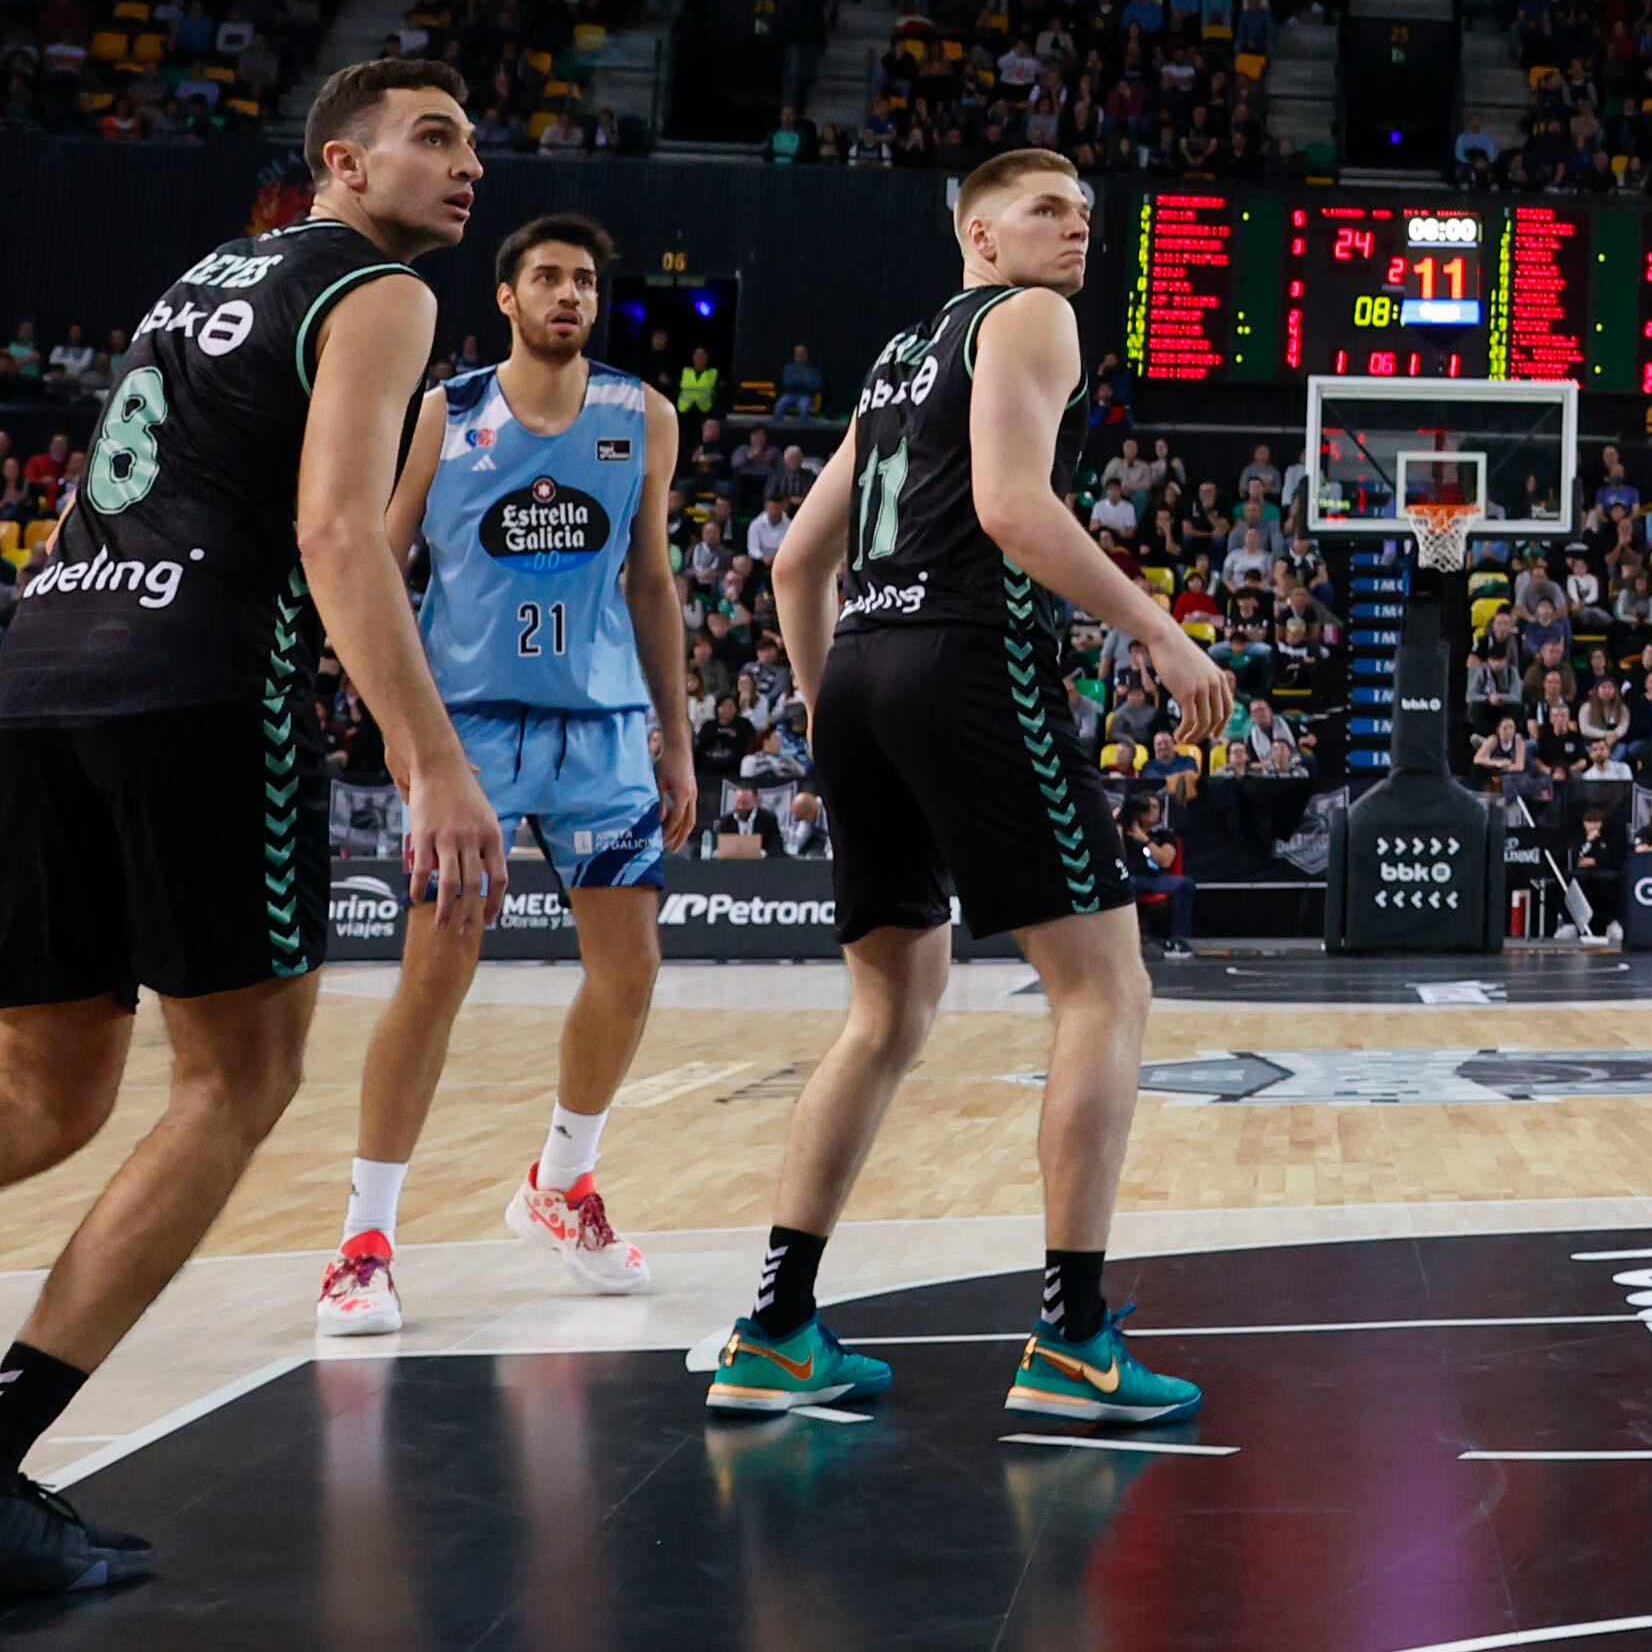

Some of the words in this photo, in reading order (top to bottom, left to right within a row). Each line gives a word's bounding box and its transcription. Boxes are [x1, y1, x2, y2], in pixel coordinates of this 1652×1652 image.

[1335, 227, 1375, 260] 24
[1387, 255, 1408, 285] 2
[1412, 255, 1466, 301] 11
[1354, 296, 1400, 327] 08:
[87, 364, 167, 515] 8
[501, 502, 589, 527] Estrella
[852, 436, 909, 572] 11
[505, 525, 585, 552] Galicia
[517, 600, 567, 658] 21
[1401, 698, 1429, 710] bbk
[1380, 861, 1430, 882] bbk
[329, 895, 399, 919] rino
[336, 920, 395, 939] viajes
